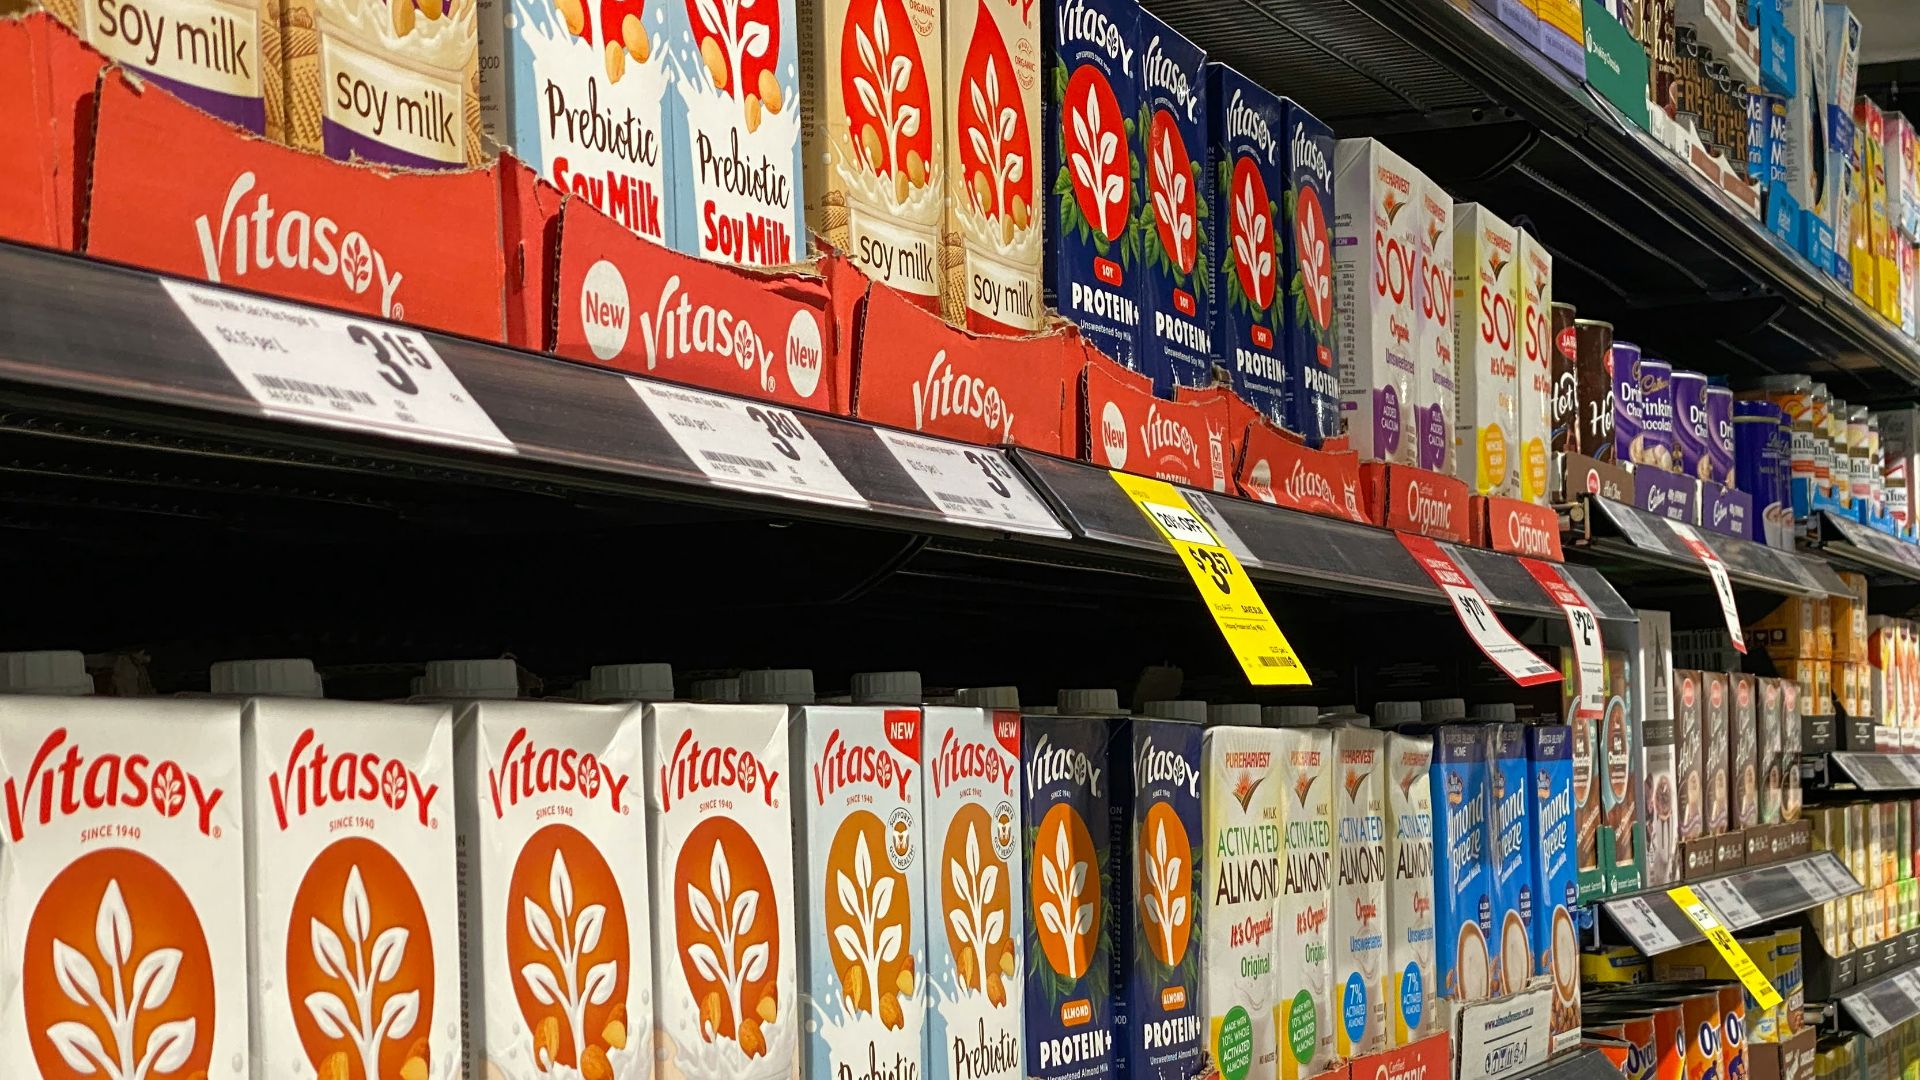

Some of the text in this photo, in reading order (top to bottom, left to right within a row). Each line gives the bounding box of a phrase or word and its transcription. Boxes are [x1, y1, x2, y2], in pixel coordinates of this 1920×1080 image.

[909, 0, 935, 17] ORGANIC
[99, 0, 250, 79] soy milk
[1015, 55, 1036, 73] ORGANIC
[336, 71, 457, 147] soy milk
[545, 76, 659, 168] Prebiotic
[696, 127, 790, 210] Prebiotic
[606, 170, 662, 240] Milk
[194, 171, 403, 318] Vitasoy
[704, 199, 791, 265] Soy Milk
[860, 236, 935, 285] soy milk
[1375, 229, 1417, 311] SOY
[585, 290, 625, 329] New
[973, 273, 1035, 320] soy milk
[1071, 281, 1140, 326] PROTEIN+
[1422, 255, 1453, 333] SOY
[640, 275, 775, 392] Vitasoy
[1155, 310, 1211, 354] PROTEIN+
[789, 335, 819, 372] New
[1236, 348, 1286, 383] PROTEIN+
[912, 349, 1014, 444] Vitasoy
[1102, 420, 1126, 450] New
[1140, 403, 1200, 468] Vitasoy
[1181, 515, 1203, 534] OFF
[1407, 480, 1452, 536] Organic
[1508, 510, 1552, 555] Organic
[890, 721, 915, 741] NEW
[998, 721, 1017, 738] NEW
[488, 726, 630, 820] Vitasoy
[660, 727, 780, 814] Vitasoy
[813, 728, 913, 806] Vitasoy
[931, 726, 1015, 799] Vitasoy
[1026, 733, 1101, 800] Vitasoy
[1133, 735, 1200, 799] Vitasoy
[1225, 752, 1271, 768] PUREHARVEST
[4, 726, 224, 843] Vitasoy
[268, 727, 440, 832] Vitasoy
[959, 787, 972, 799] SINCE
[1050, 789, 1062, 800] SINCE
[535, 804, 574, 820] SINCE 1940
[698, 798, 733, 814] SINCE 1940
[846, 794, 873, 806] SINCE 1940
[1263, 806, 1277, 819] MILK
[1316, 803, 1328, 816] MILK
[80, 823, 141, 843] SINCE 1940
[328, 816, 375, 832] SINCE 1940
[1217, 824, 1279, 857] ACTIVATED
[1284, 820, 1330, 850] ACTIVATED
[1338, 816, 1383, 844] ACTIVATED
[1397, 814, 1431, 840] ACTIVATED
[1284, 852, 1331, 895] ALMOND
[1338, 845, 1386, 886] ALMOND
[1396, 842, 1433, 880] ALMOND
[1453, 828, 1482, 886] Breeze
[1216, 857, 1280, 906] ALMOND
[1296, 913, 1306, 935] It's
[1355, 897, 1377, 927] Organic
[1230, 923, 1244, 948] It's
[1240, 953, 1270, 980] Original
[1305, 941, 1327, 967] Original
[1163, 992, 1185, 1007] ALMOND
[1350, 984, 1362, 1005] 7%
[1407, 973, 1420, 993] 7%
[1064, 1005, 1089, 1022] ALMOND
[1224, 1016, 1247, 1033] MADE WITH
[953, 1017, 1019, 1075] Prebiotic
[1144, 1015, 1201, 1049] PROTEIN+
[1222, 1027, 1250, 1048] 10% WHOLE
[1293, 1022, 1315, 1043] ACTIVATED
[838, 1041, 918, 1080] Pbiotic
[1040, 1030, 1112, 1069] PROTEIN+
[1149, 1048, 1199, 1066] Unsweetened Almond Milk
[1223, 1040, 1250, 1062] ACTIVATED
[1226, 1056, 1249, 1074] ALMONDS
[1081, 1062, 1109, 1078] Almond Milk
